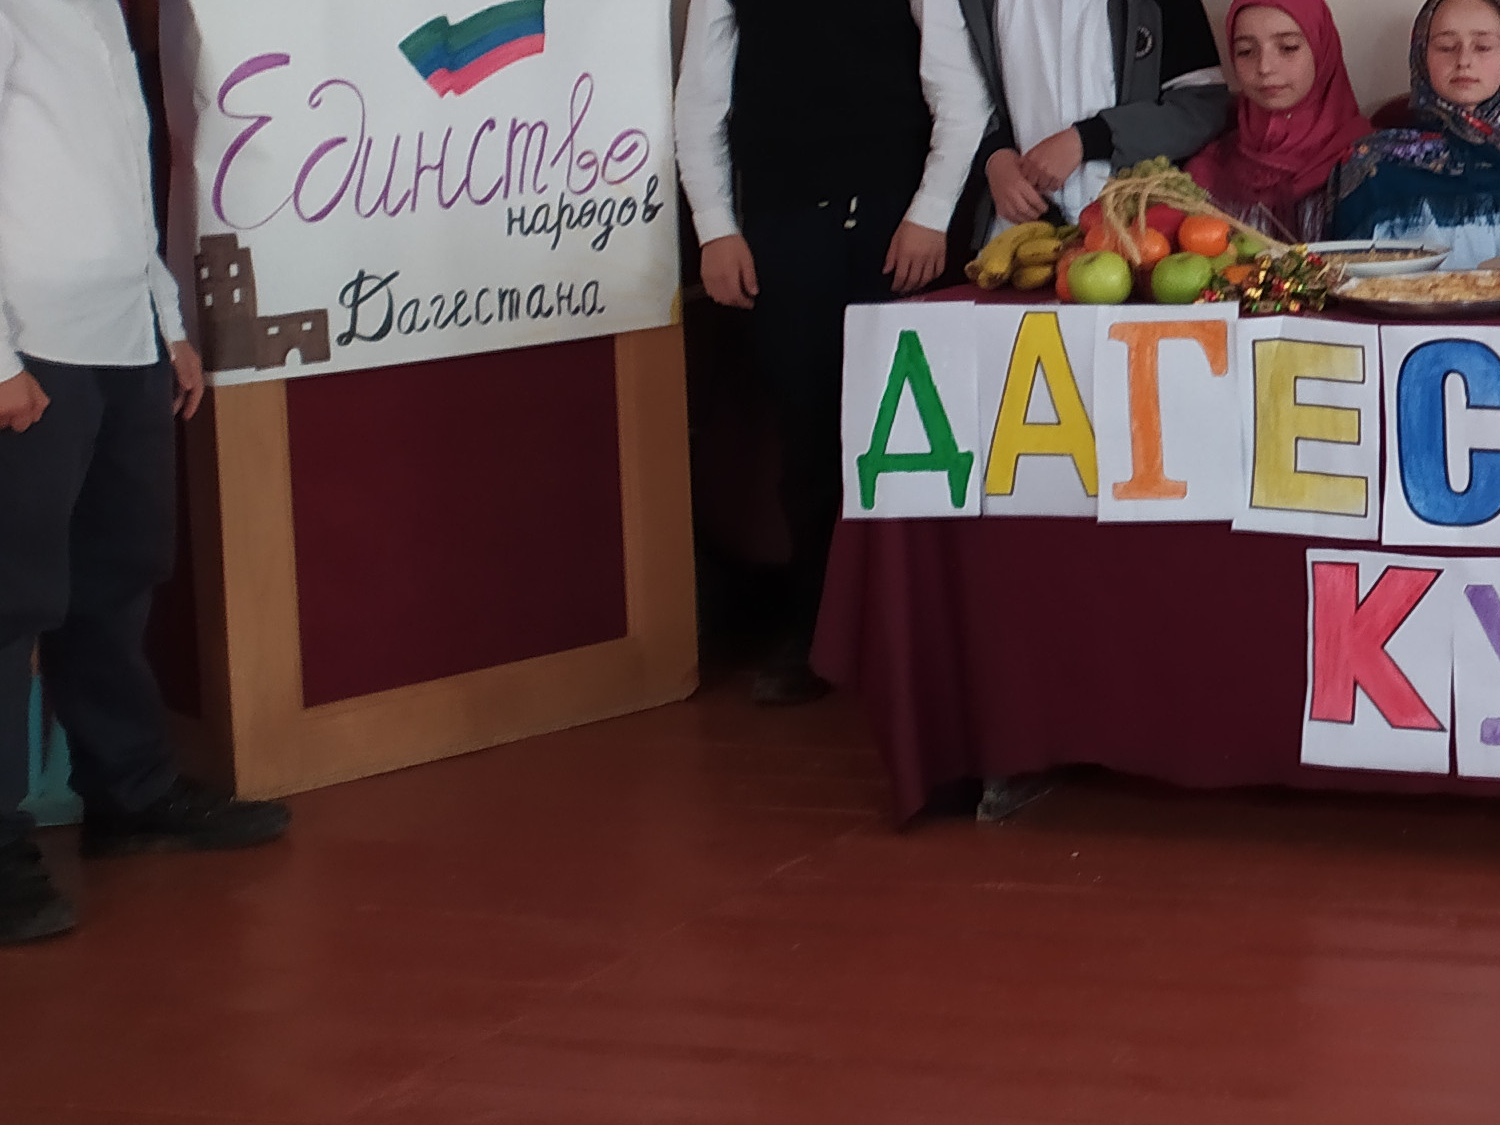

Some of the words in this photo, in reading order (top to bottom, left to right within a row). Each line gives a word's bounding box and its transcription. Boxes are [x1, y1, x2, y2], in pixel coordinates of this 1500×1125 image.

[211, 52, 650, 230] Единство
[507, 174, 664, 251] народов
[337, 269, 606, 346] Дагестана
